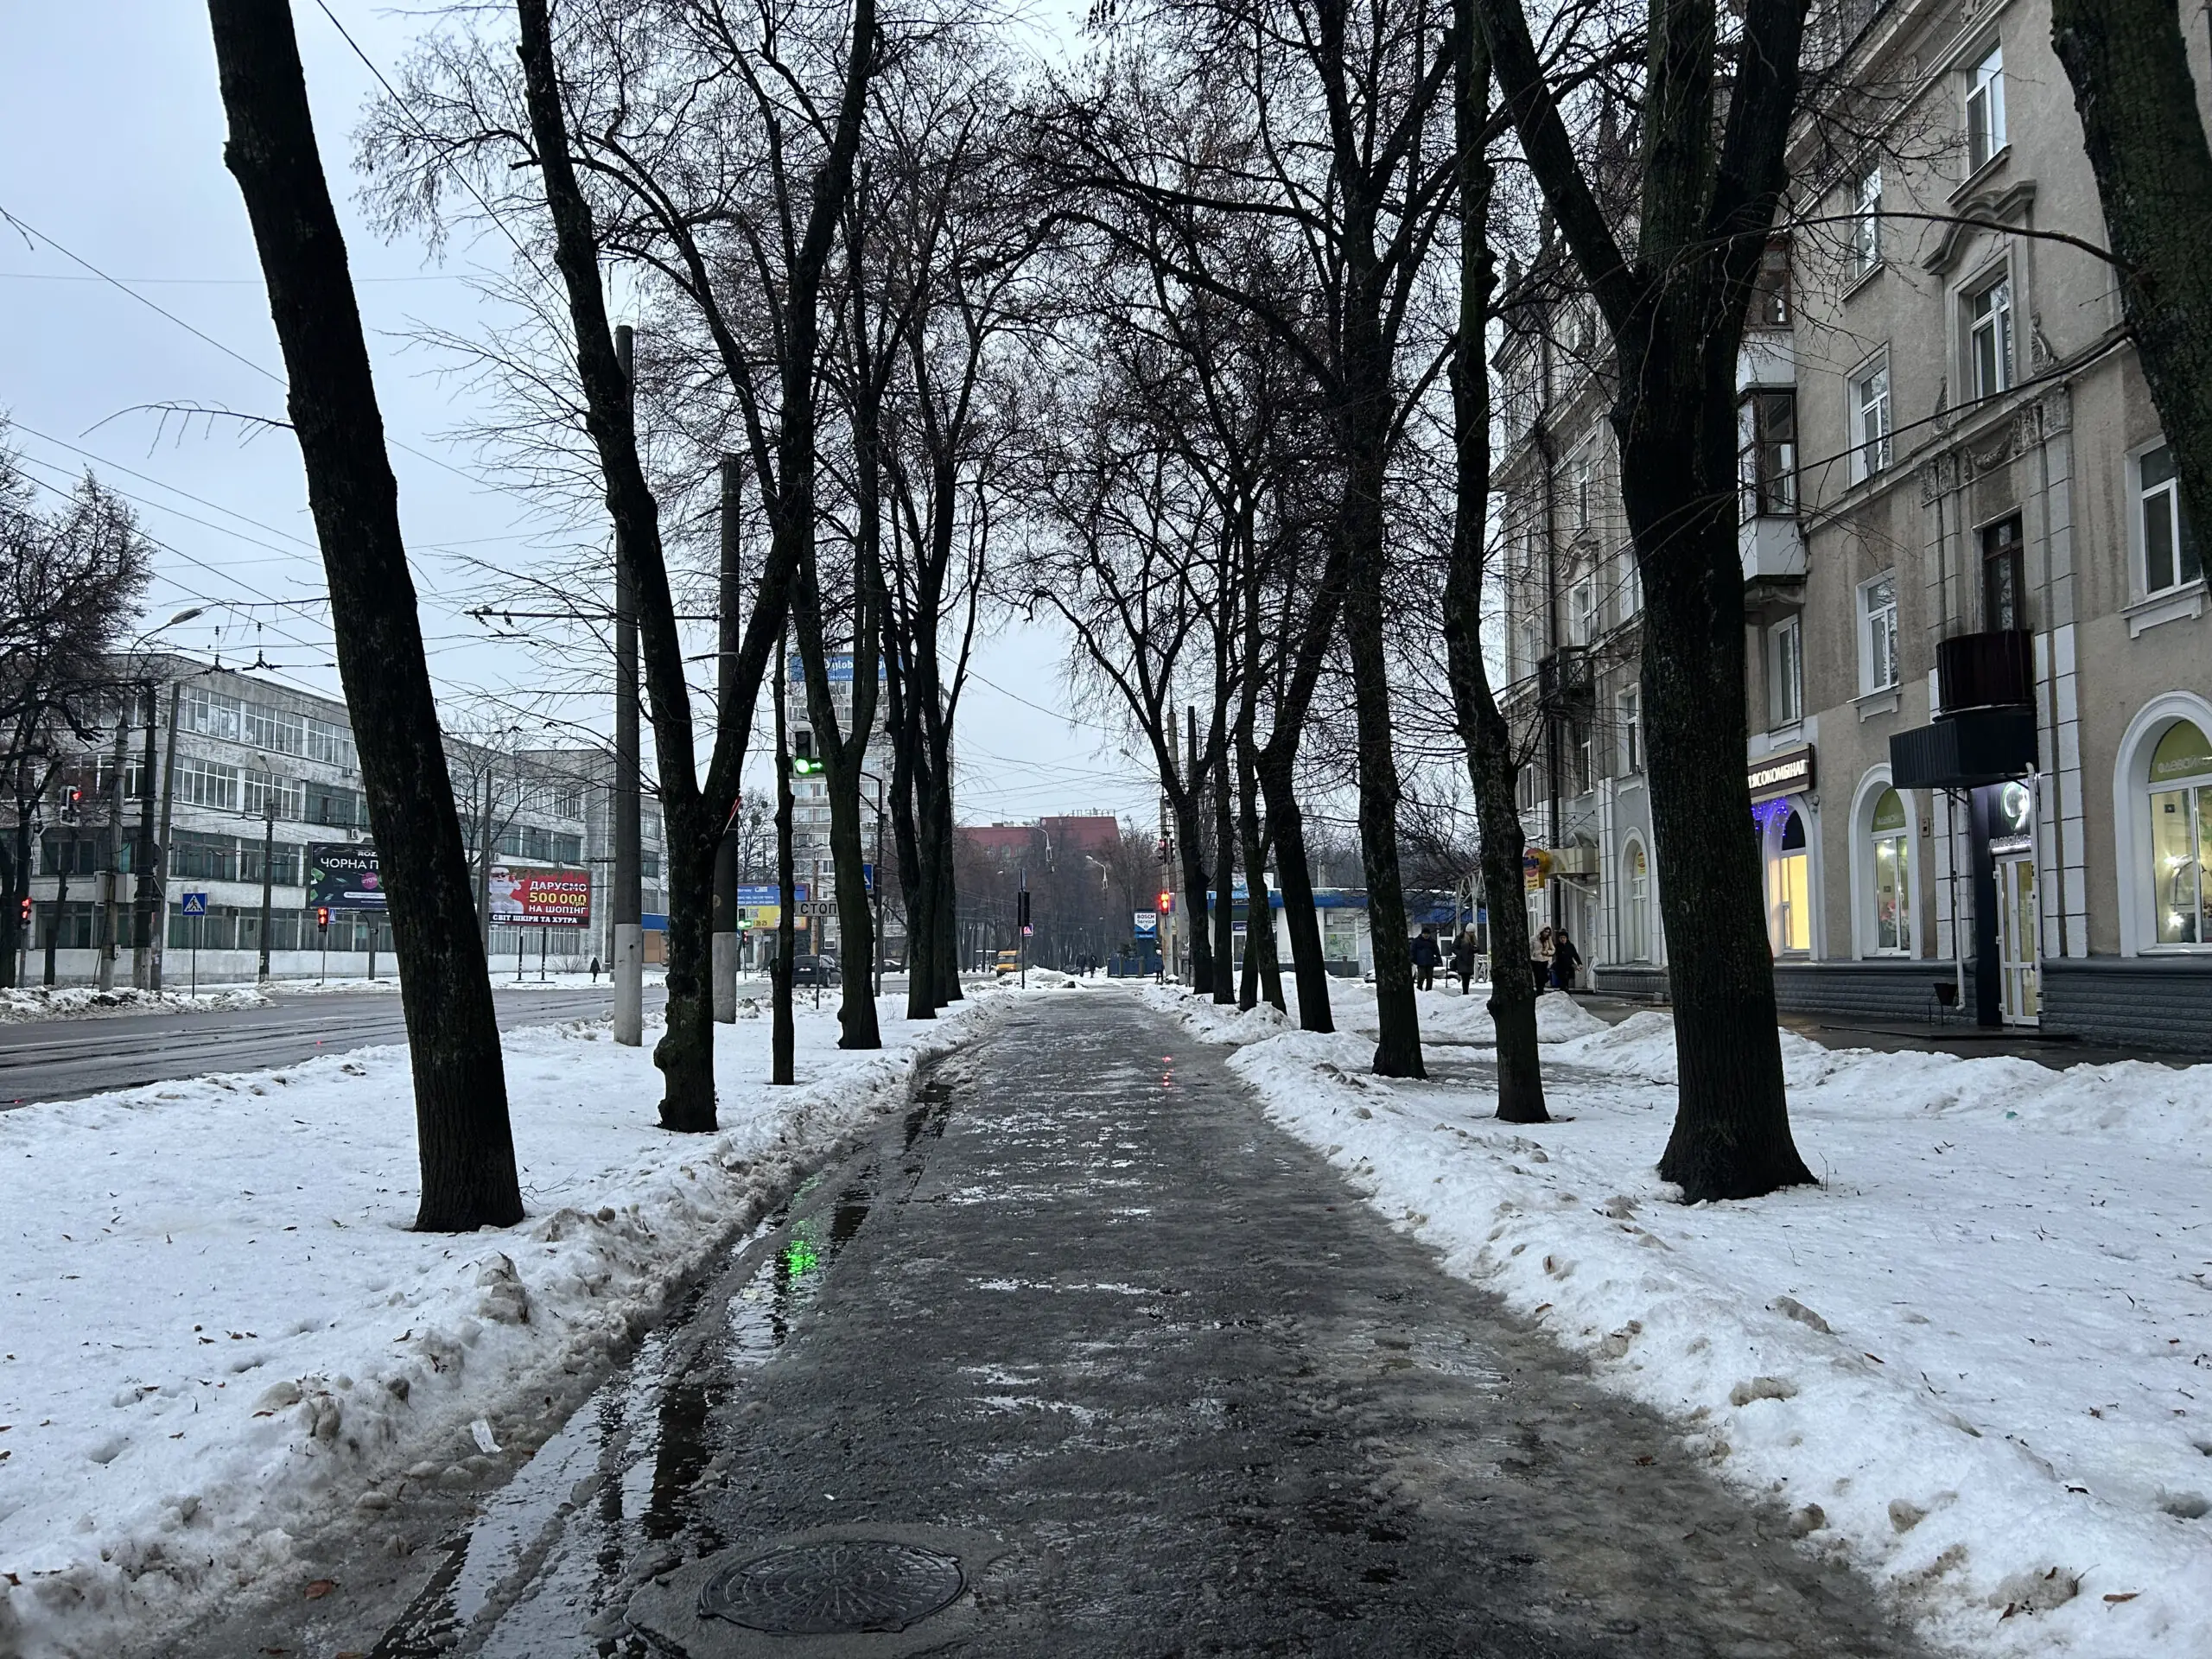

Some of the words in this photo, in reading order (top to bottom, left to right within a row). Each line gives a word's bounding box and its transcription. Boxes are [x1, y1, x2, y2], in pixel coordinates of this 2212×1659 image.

[321, 857, 367, 869] ЧОРНА
[370, 860, 379, 870] П
[530, 881, 587, 892] ДАРУЄМО
[529, 893, 557, 904] 500
[559, 893, 588, 905] 000
[800, 903, 837, 914] СТОП
